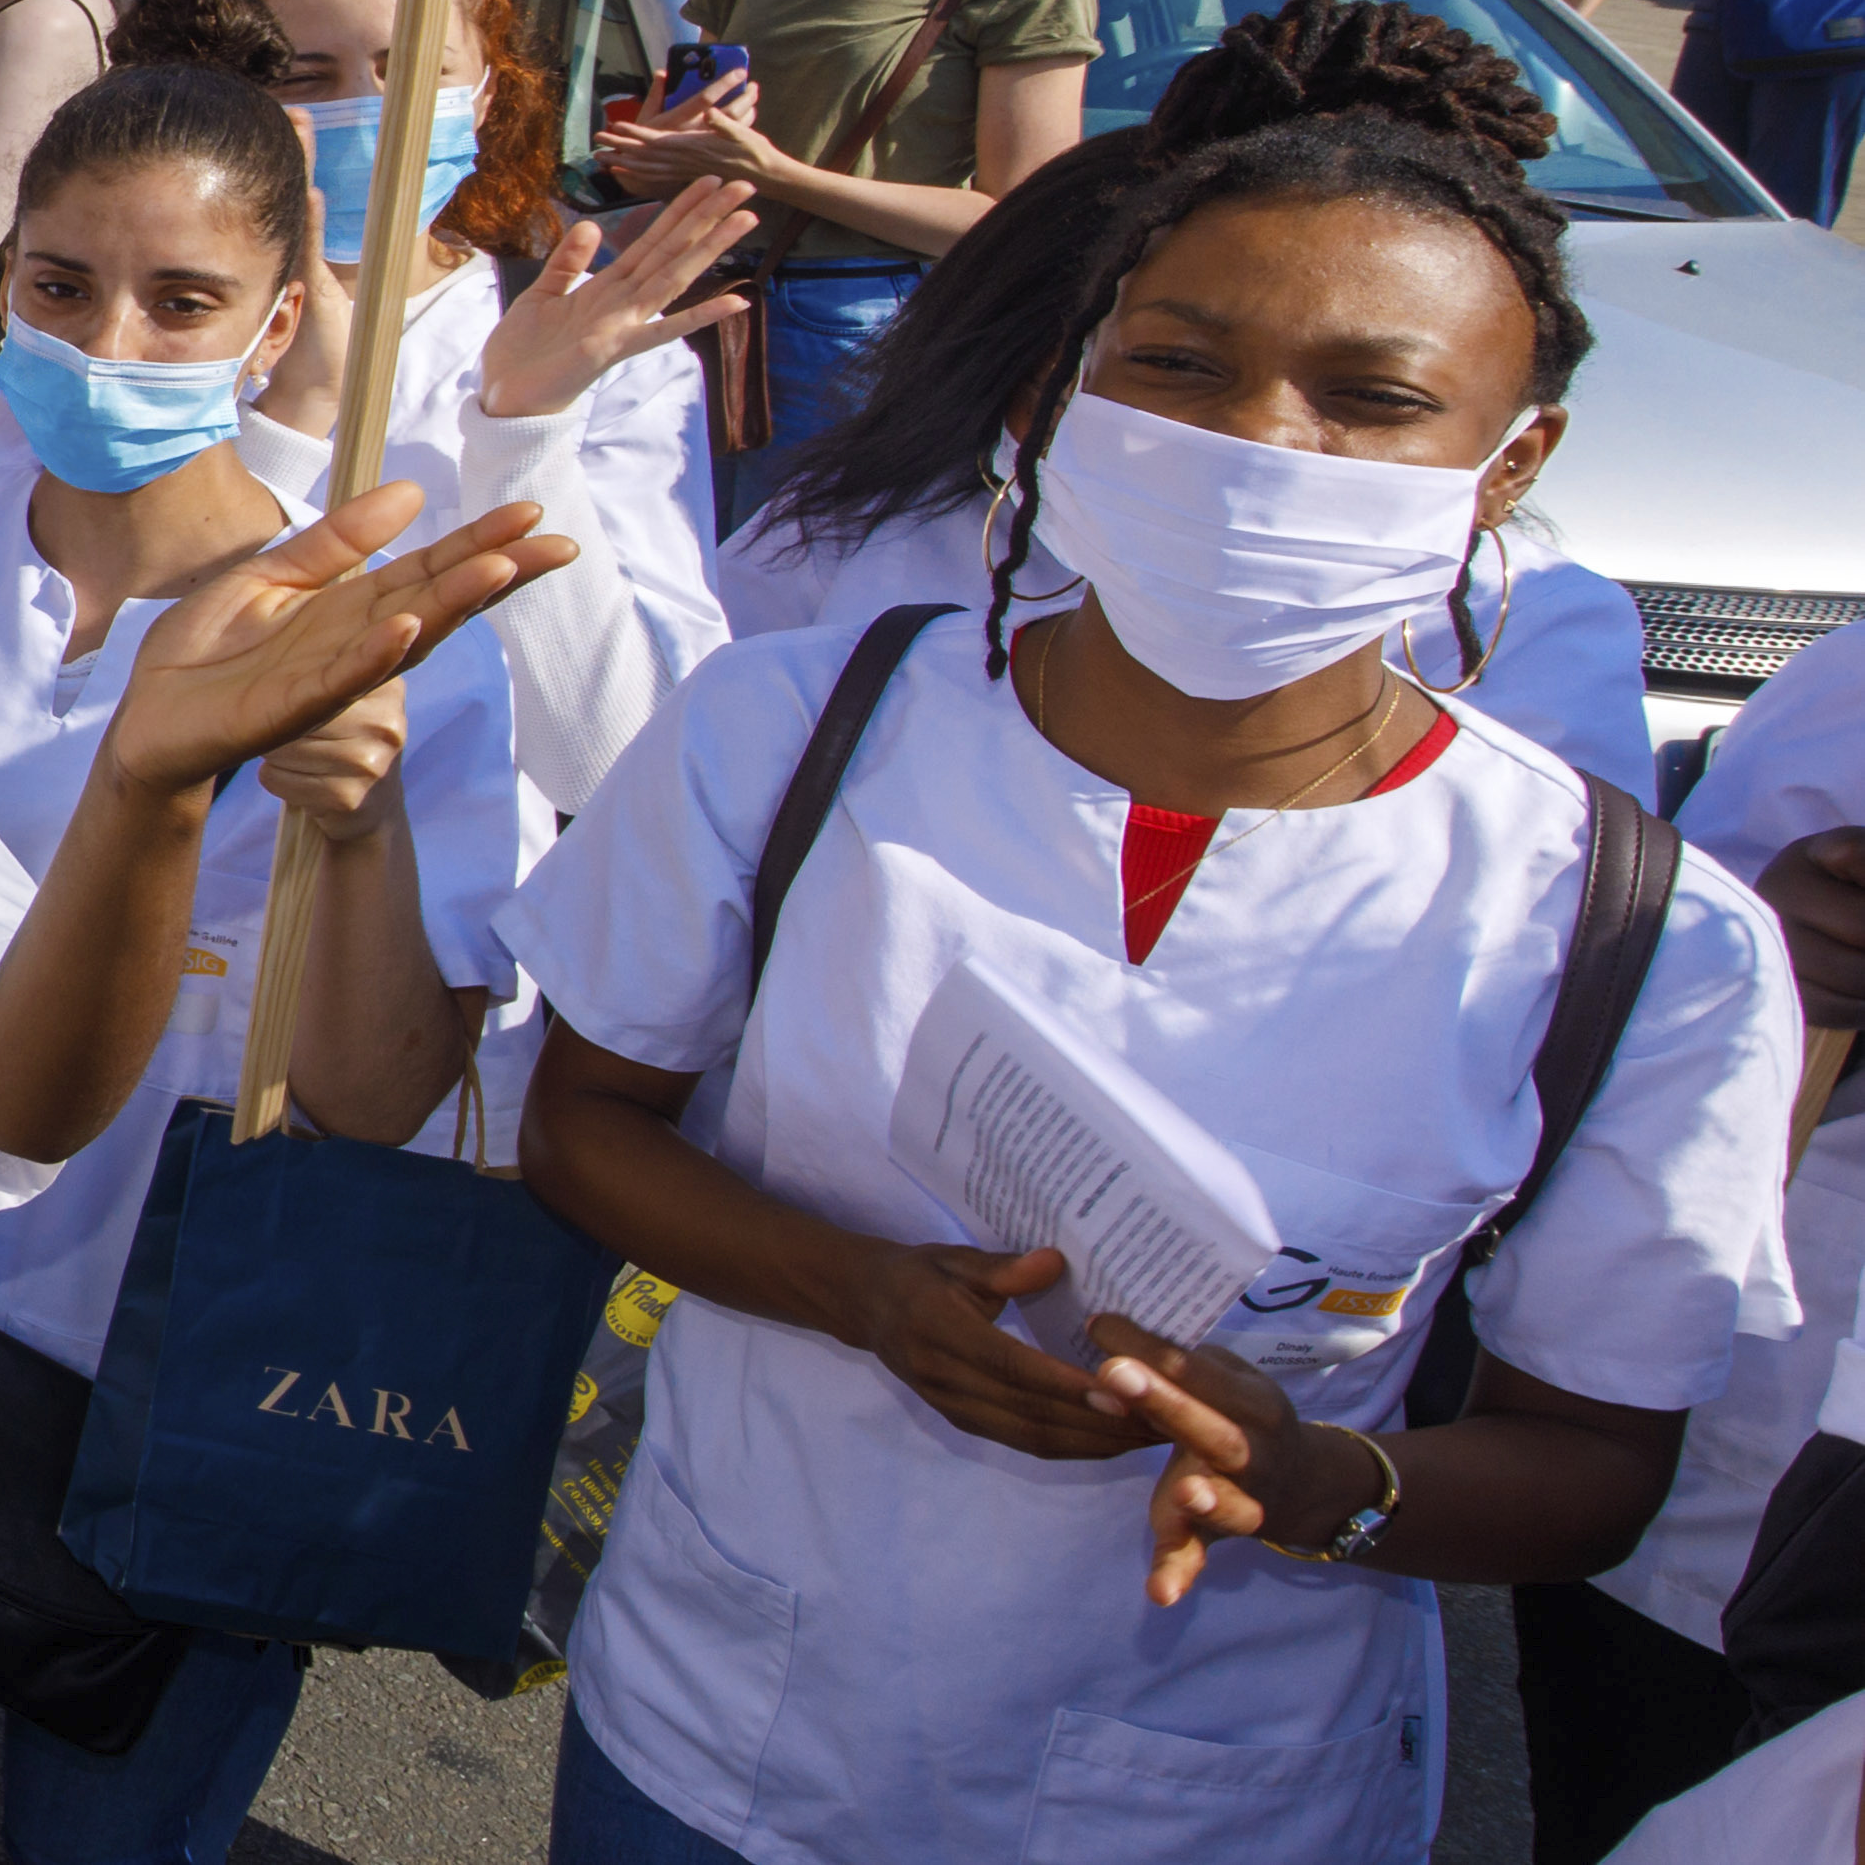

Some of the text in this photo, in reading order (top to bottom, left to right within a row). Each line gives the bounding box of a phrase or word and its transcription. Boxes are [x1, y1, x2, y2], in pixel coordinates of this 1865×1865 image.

[185, 951, 220, 972] SIG
[1327, 1265, 1364, 1279] Haute
[624, 1280, 673, 1323] Prad
[257, 1366, 474, 1452] ZARA
